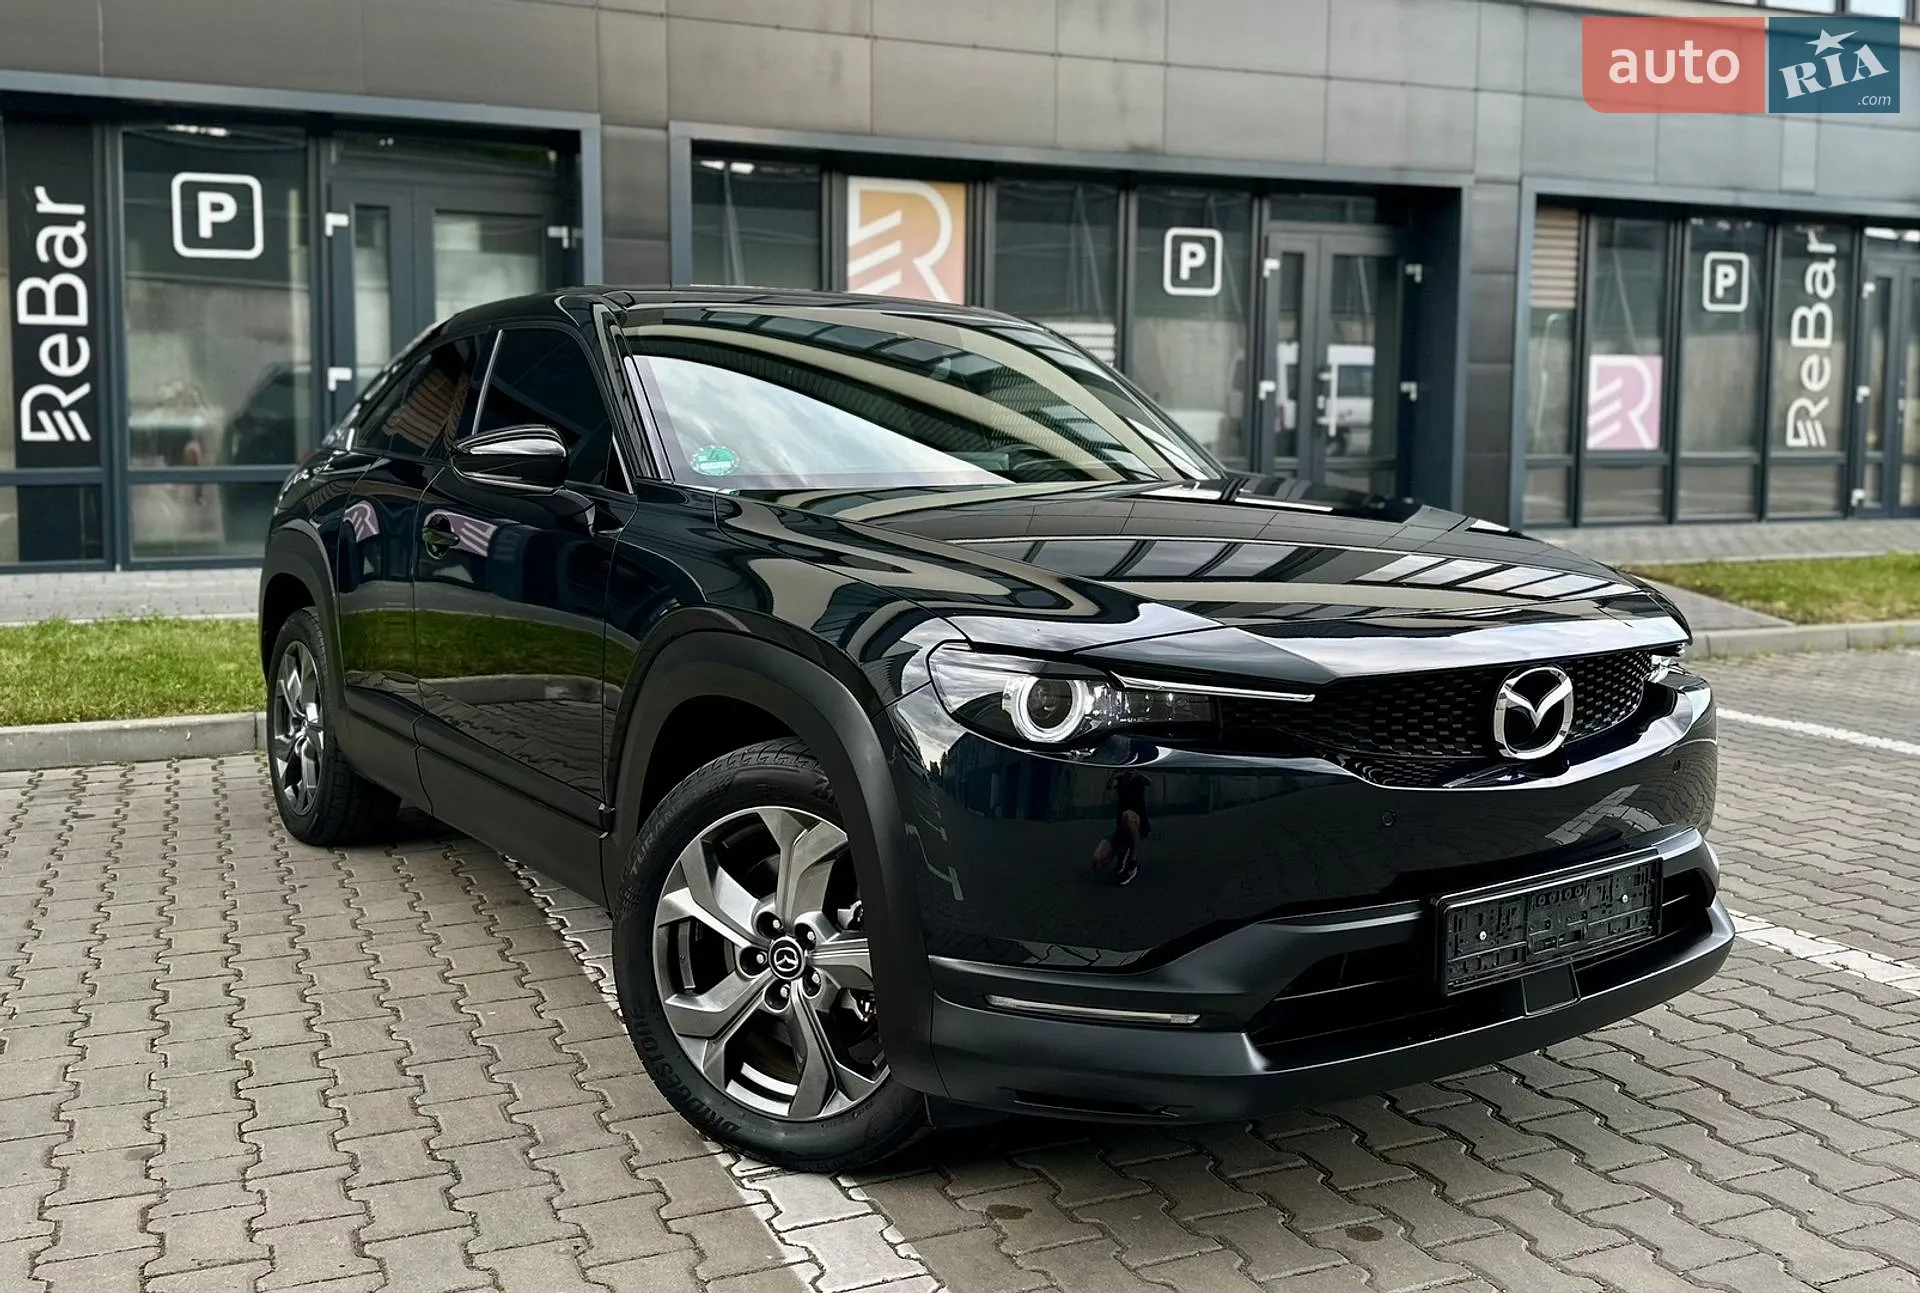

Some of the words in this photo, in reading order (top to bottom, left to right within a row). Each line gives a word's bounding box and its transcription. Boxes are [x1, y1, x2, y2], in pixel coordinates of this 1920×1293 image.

[198, 191, 237, 238] P
[1180, 242, 1206, 281] P
[1715, 264, 1737, 299] P
[17, 186, 91, 441] ReBar
[1786, 228, 1837, 447] ReBar
